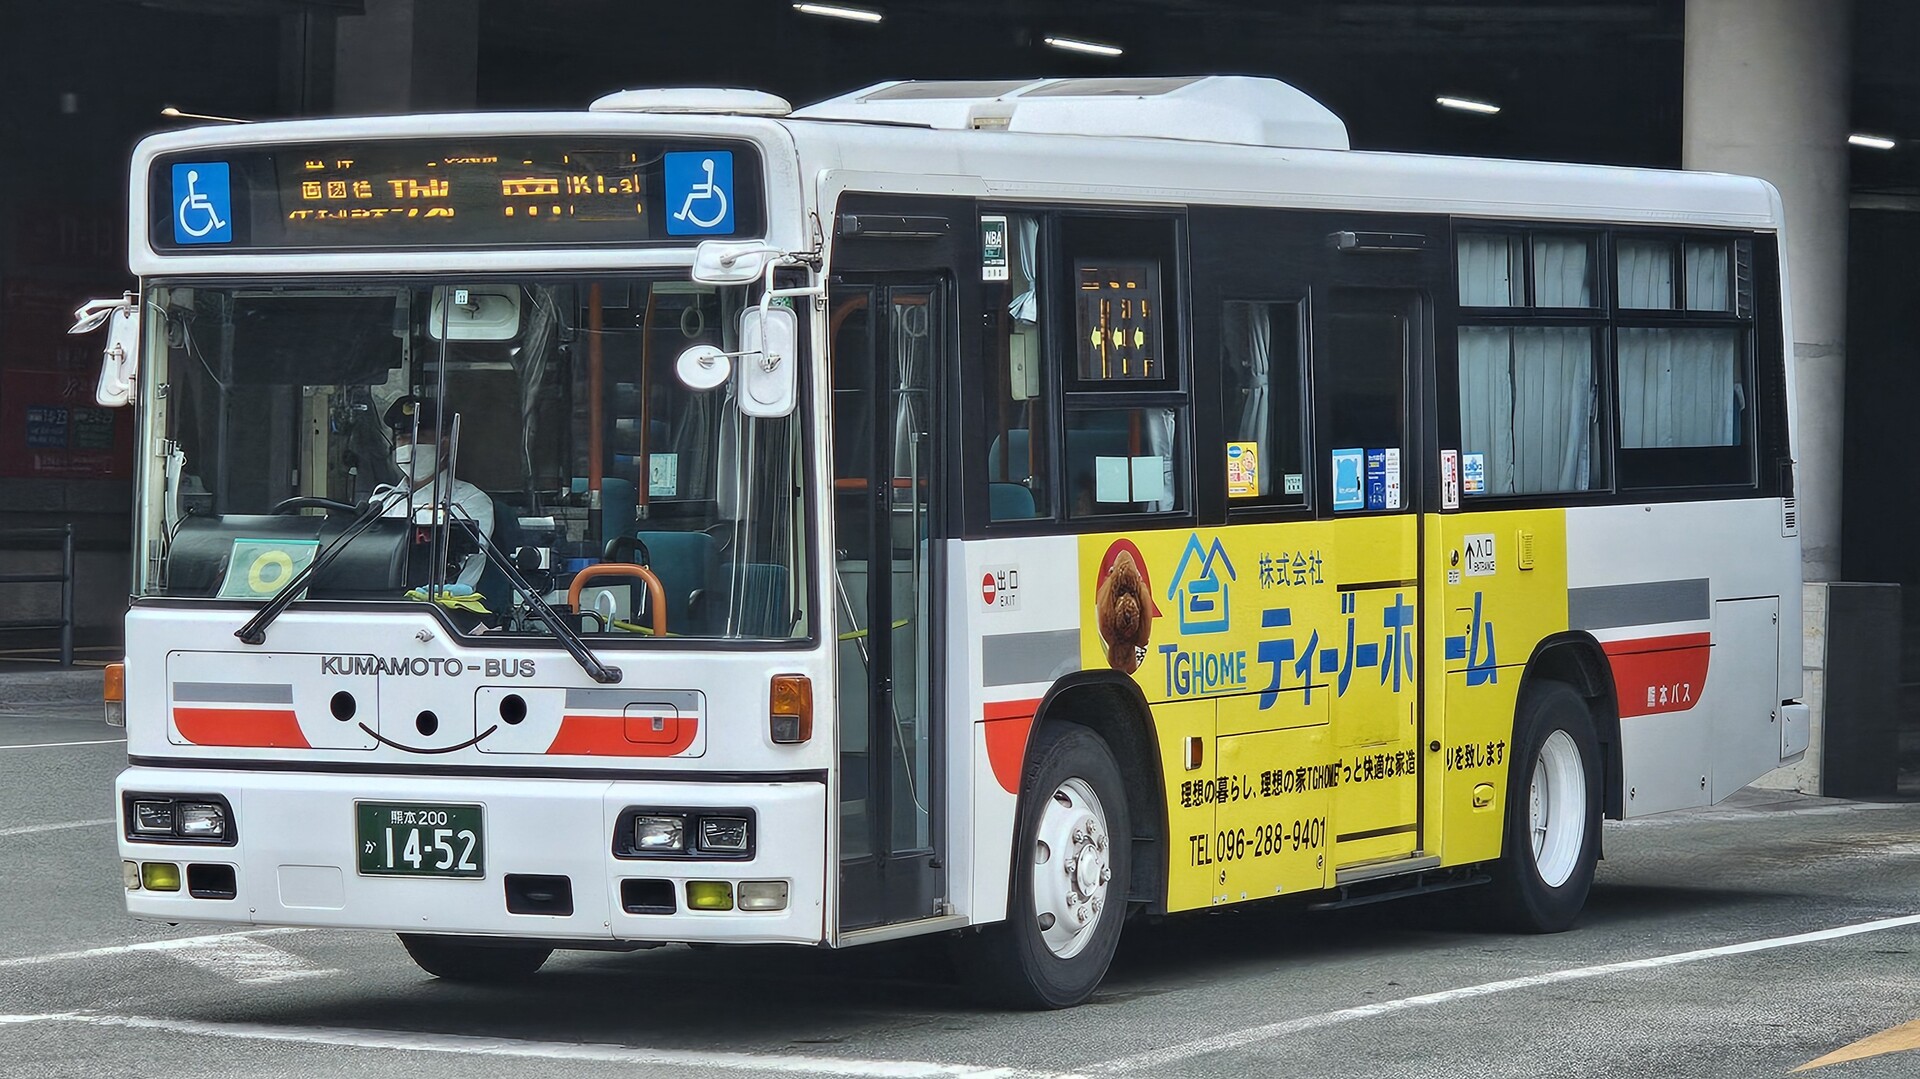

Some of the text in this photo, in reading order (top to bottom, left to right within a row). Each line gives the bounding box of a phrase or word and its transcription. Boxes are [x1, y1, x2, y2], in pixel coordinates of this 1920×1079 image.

[1476, 539, 1493, 558] 入口
[997, 570, 1018, 590] 出口
[1259, 550, 1324, 589] 株式会社
[1001, 594, 1015, 607] EXIT
[1158, 643, 1247, 698] TGHOME
[365, 827, 477, 871] か 14-52
[1189, 816, 1326, 867] TEL 096-288-9401
